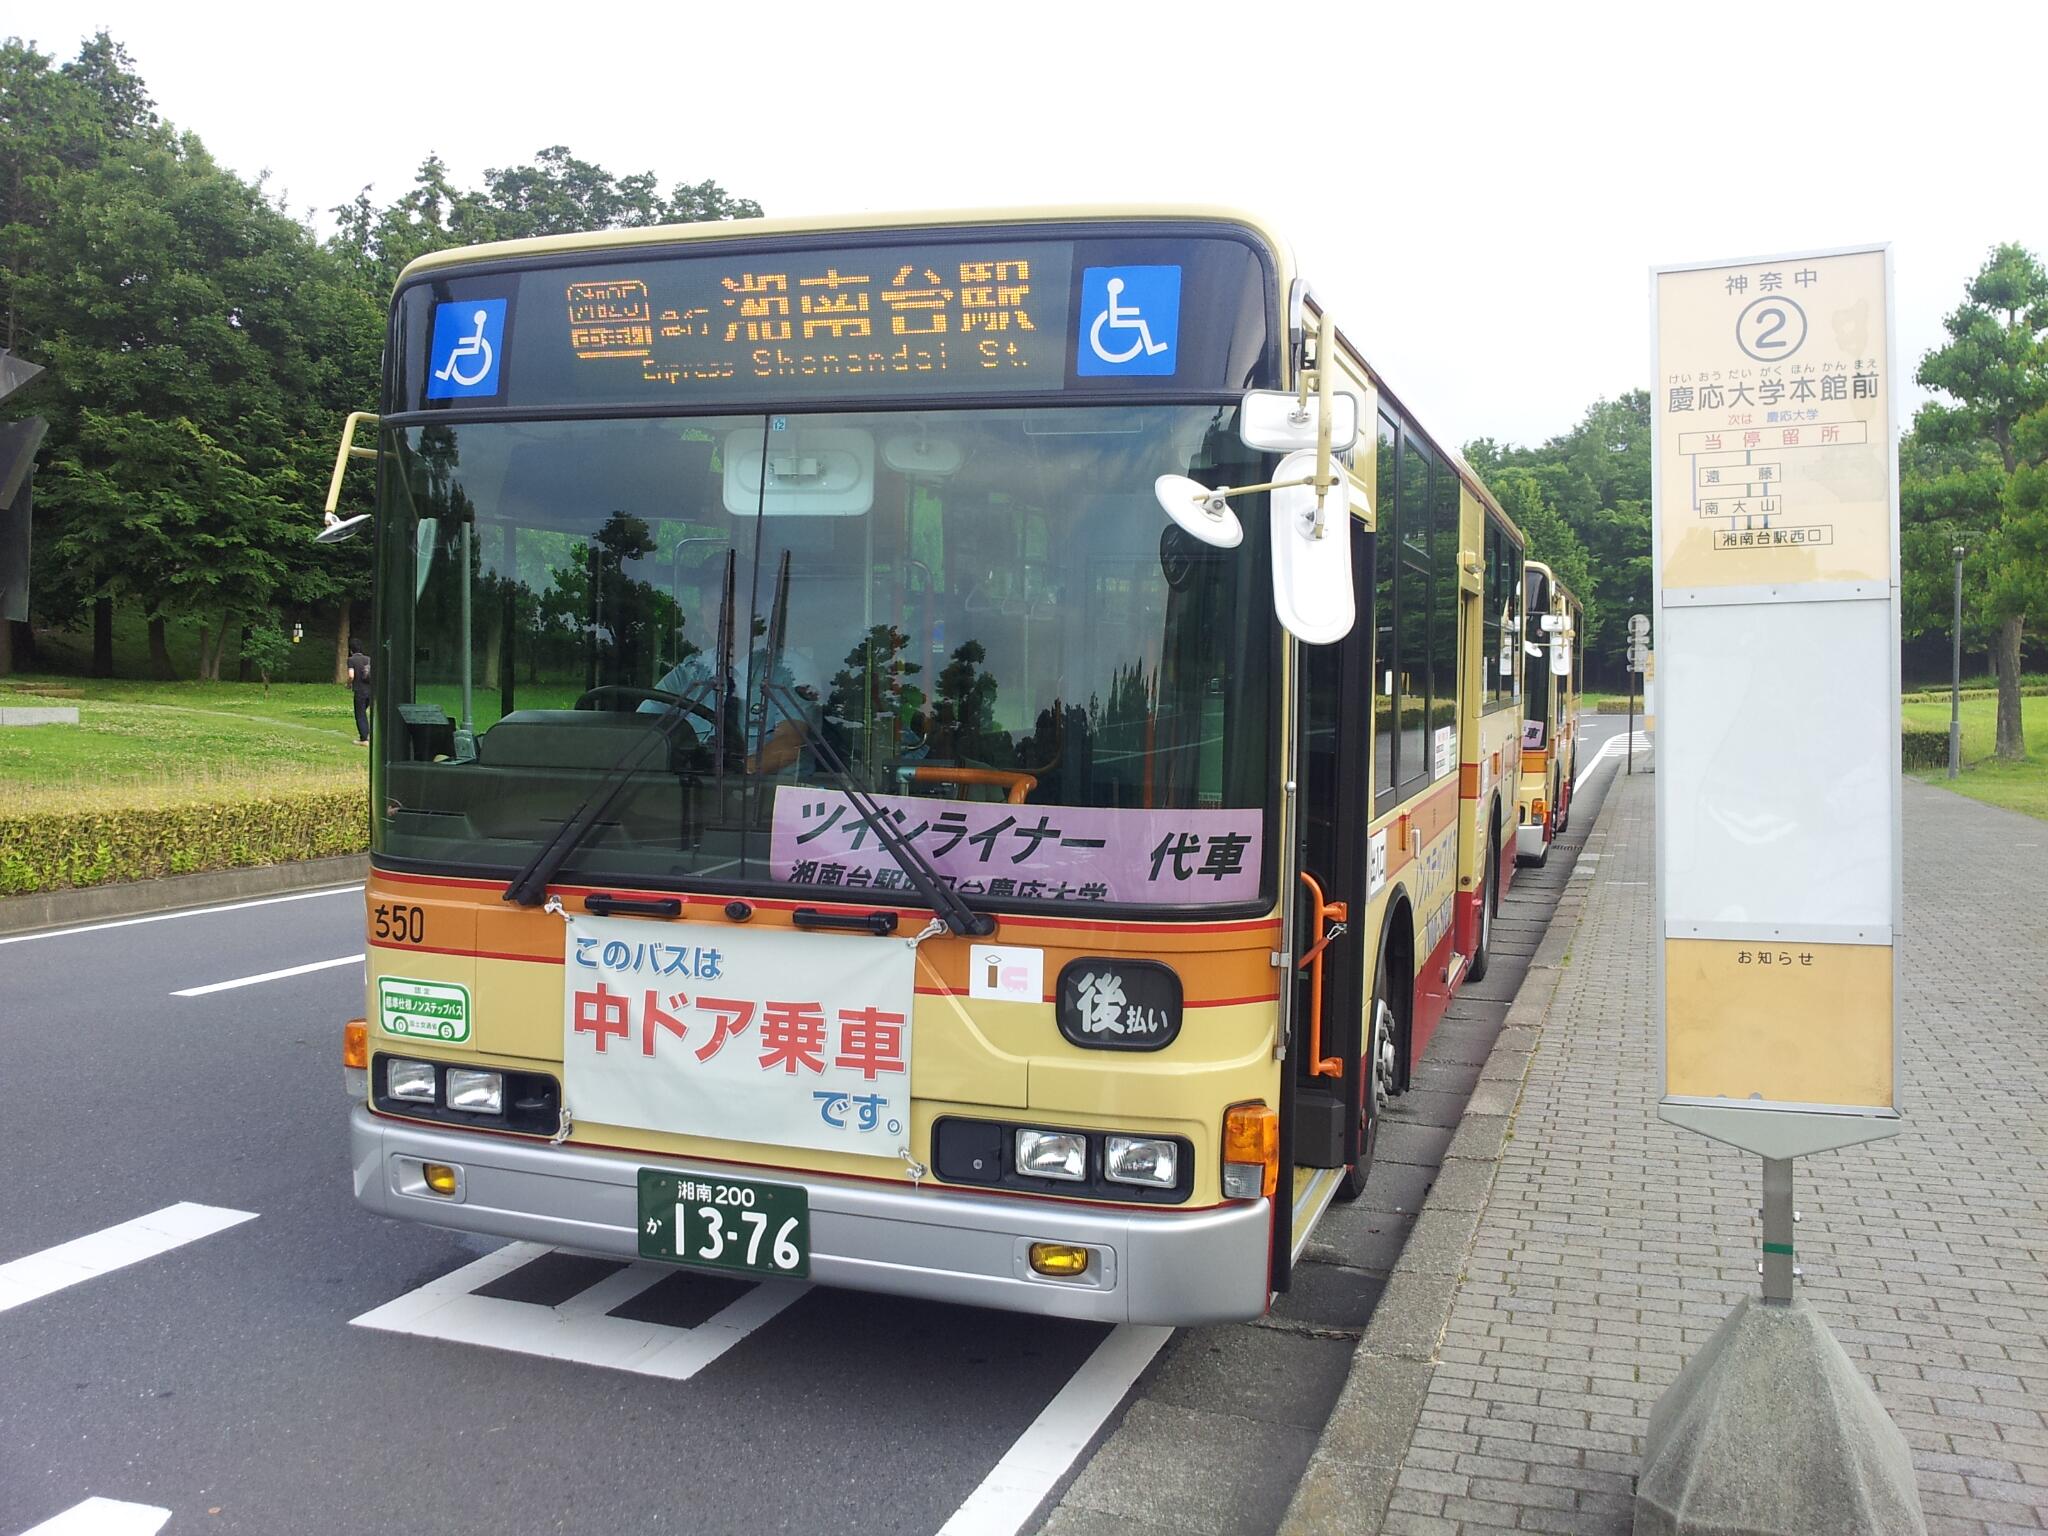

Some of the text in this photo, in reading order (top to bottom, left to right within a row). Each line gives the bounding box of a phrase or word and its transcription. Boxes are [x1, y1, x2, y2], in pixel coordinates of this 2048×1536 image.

[721, 260, 1036, 342] 湘南台駅
[1725, 268, 1818, 296] 神奈中
[1668, 371, 1880, 414] 慶応大学本館前
[1727, 408, 1819, 426] 次は 慶応大学
[1704, 425, 1841, 450] 当停留所
[1705, 466, 1773, 483] 遠藤
[1704, 498, 1775, 515] 南大山
[1722, 529, 1821, 547] 湘南台駅西口
[796, 801, 1252, 882] ツインライナー 代車
[374, 904, 424, 943] ち50
[575, 937, 722, 979] このバスは
[1737, 951, 1814, 967] お知らせ
[1076, 972, 1169, 1035] 後払い
[573, 981, 906, 1081] 中ドア乗車
[812, 1090, 903, 1135] です。
[677, 1181, 755, 1208] 湘南200
[646, 1202, 800, 1270] か 13-76
